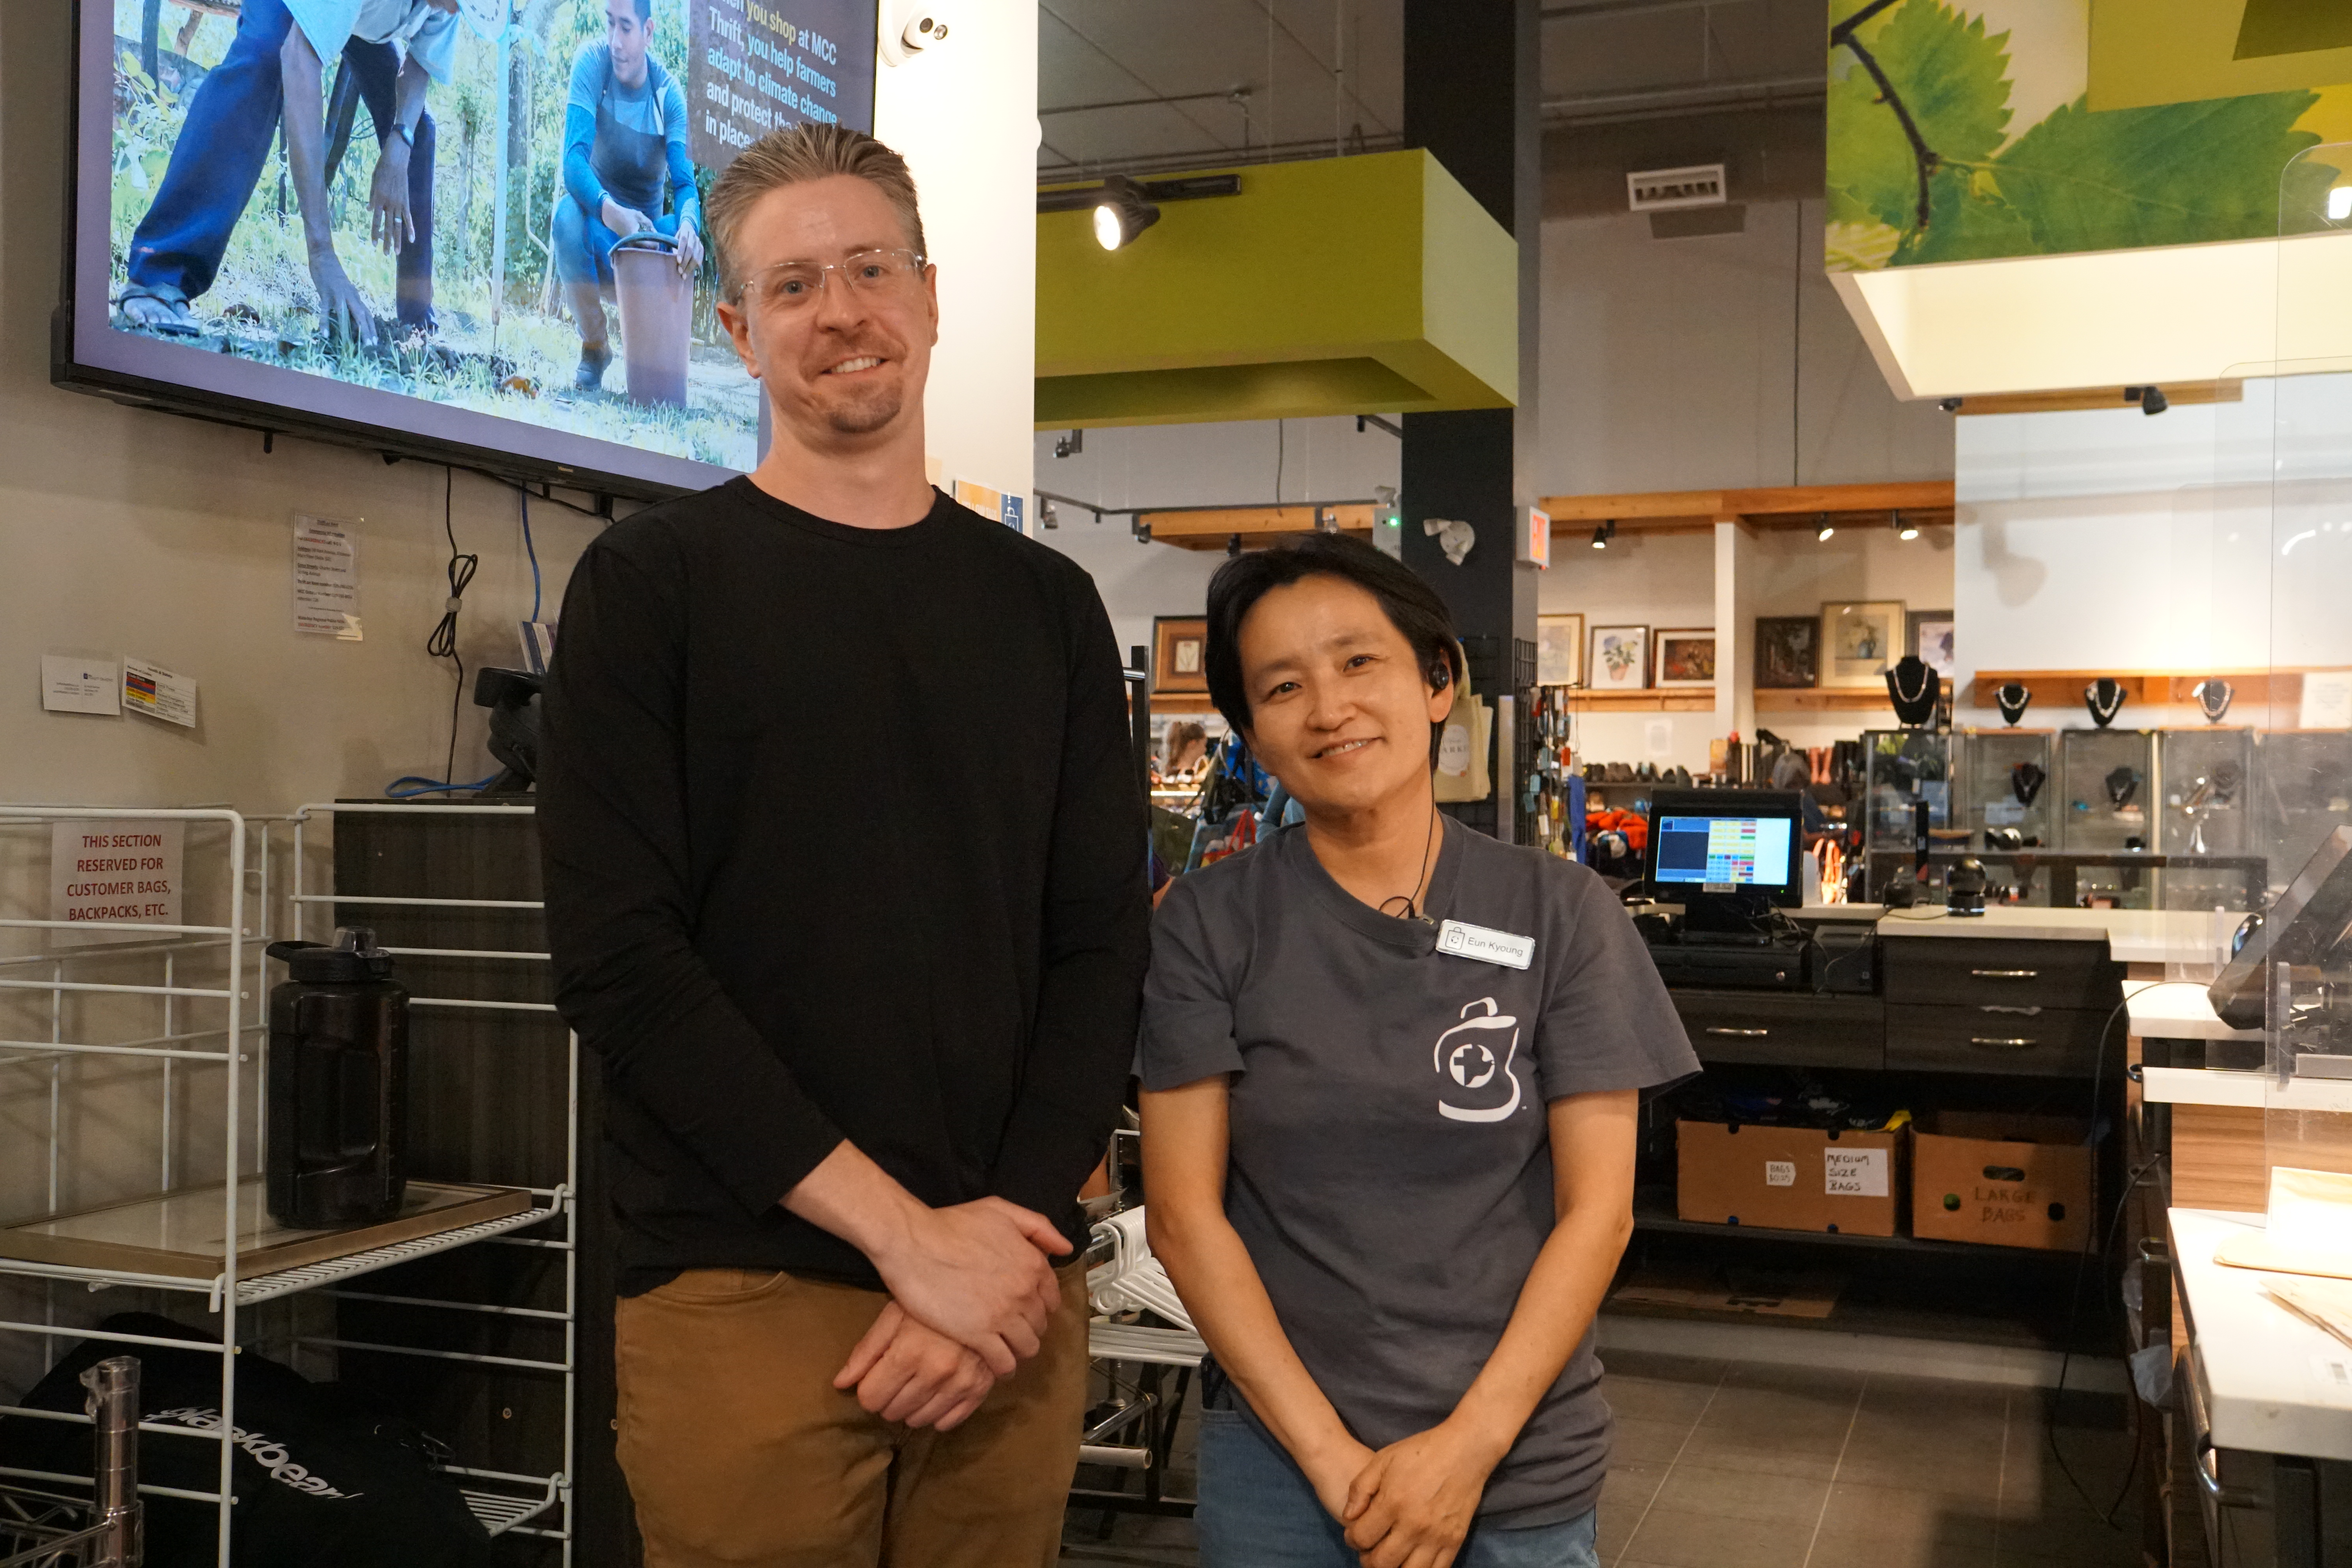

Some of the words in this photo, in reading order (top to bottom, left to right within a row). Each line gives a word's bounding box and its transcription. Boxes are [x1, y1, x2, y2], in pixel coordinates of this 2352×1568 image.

[747, 0, 767, 25] you
[769, 11, 796, 45] shop
[798, 29, 809, 50] at
[812, 32, 837, 65] MCC
[709, 6, 744, 52] Thrift,
[748, 34, 768, 61] you
[771, 42, 793, 77] help
[796, 56, 836, 98] farmers
[708, 47, 742, 81] adapt
[744, 62, 756, 87] to
[759, 71, 798, 109] climate
[800, 94, 837, 129] change
[707, 81, 729, 107] and
[731, 93, 772, 129] protect
[706, 109, 717, 136] in
[83, 835, 109, 848] THIS
[112, 835, 161, 847] SECTION
[77, 858, 137, 872] RESERVED
[141, 858, 163, 869] FOR
[67, 882, 134, 896] CUSTOMER
[138, 880, 171, 894] BAGS,
[69, 905, 141, 920] BACKPACKS,
[145, 904, 168, 916] ETC.
[1468, 937, 1485, 947] Eun
[1489, 942, 1523, 957] Kyoung
[1827, 1154, 1869, 1166] MEDIUM
[1828, 1168, 1857, 1177] SIZE
[1829, 1180, 1861, 1191] BAGS
[1975, 1187, 2035, 1204] LARGE
[1982, 1206, 2026, 1222] BAGS
